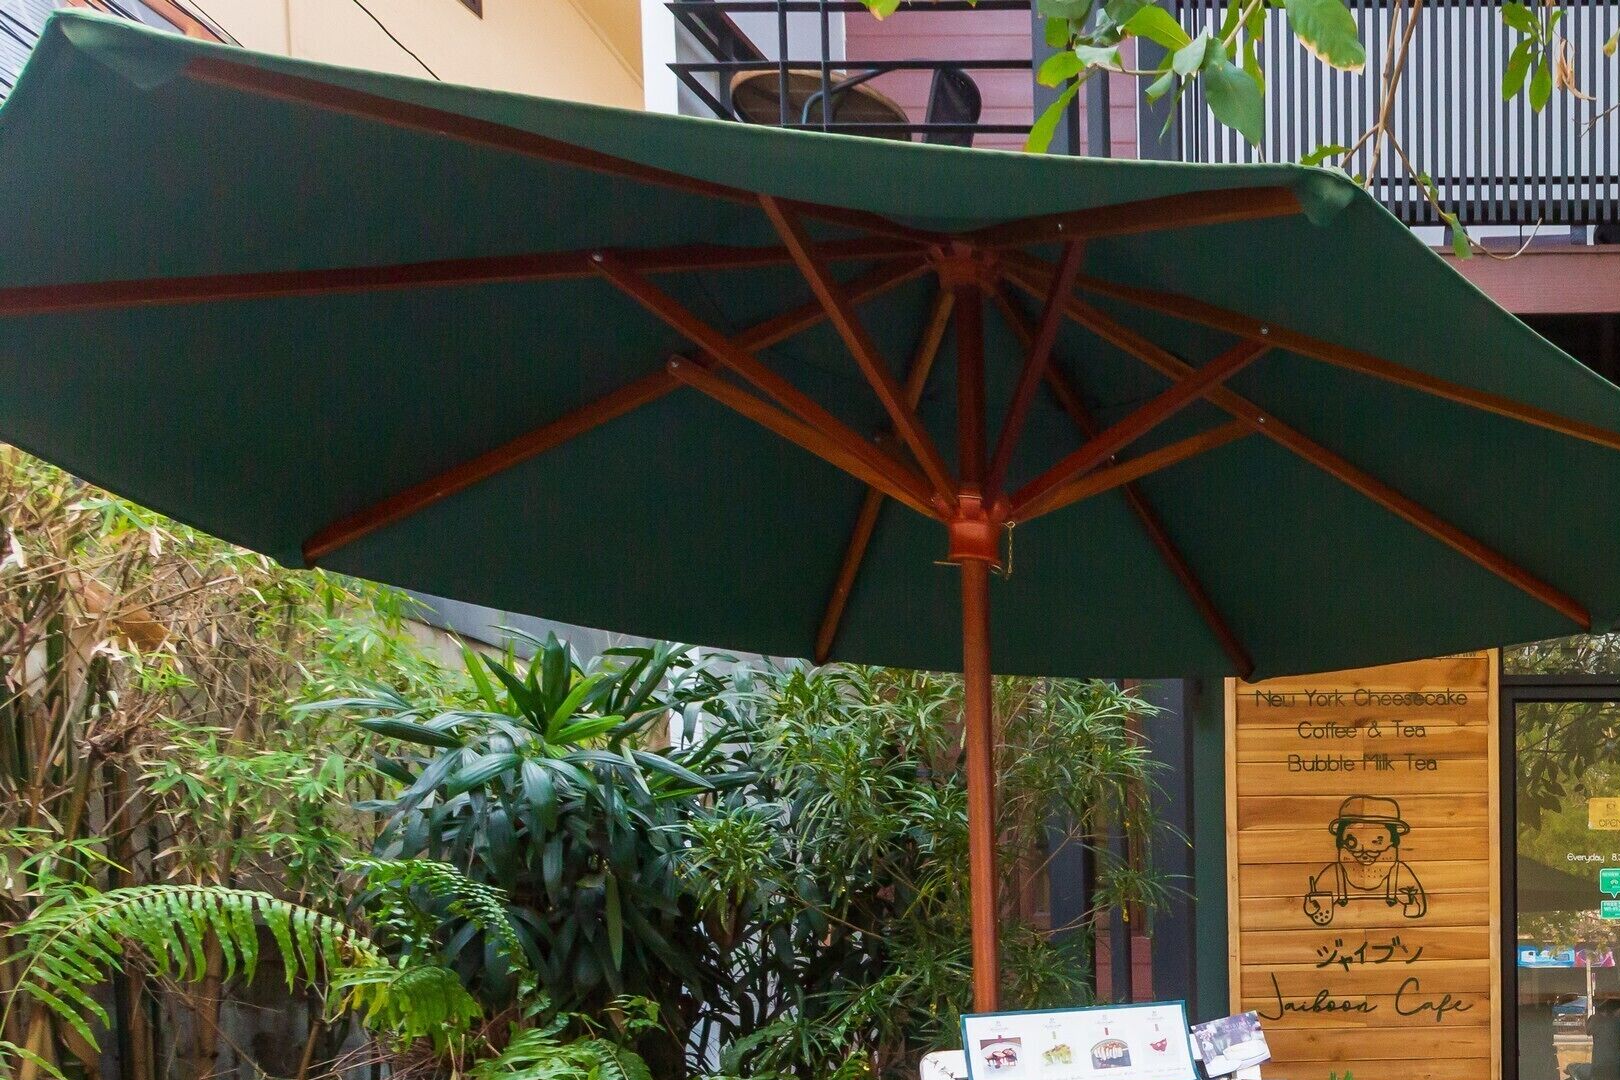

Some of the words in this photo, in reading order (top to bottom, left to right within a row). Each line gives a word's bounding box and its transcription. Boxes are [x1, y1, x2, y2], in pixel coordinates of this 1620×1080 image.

[1255, 689, 1295, 707] New
[1304, 688, 1345, 707] York
[1354, 688, 1468, 707] Cheesecake
[1297, 720, 1357, 739] Coffee
[1367, 720, 1382, 738] &
[1391, 719, 1427, 738] Tea
[1287, 753, 1355, 772] Bubble
[1363, 752, 1395, 771] Milk
[1404, 752, 1438, 771] Tea
[1566, 853, 1605, 863] Everyday
[1259, 972, 1378, 1021] Jaiboon
[1395, 977, 1474, 1022] Cafe
